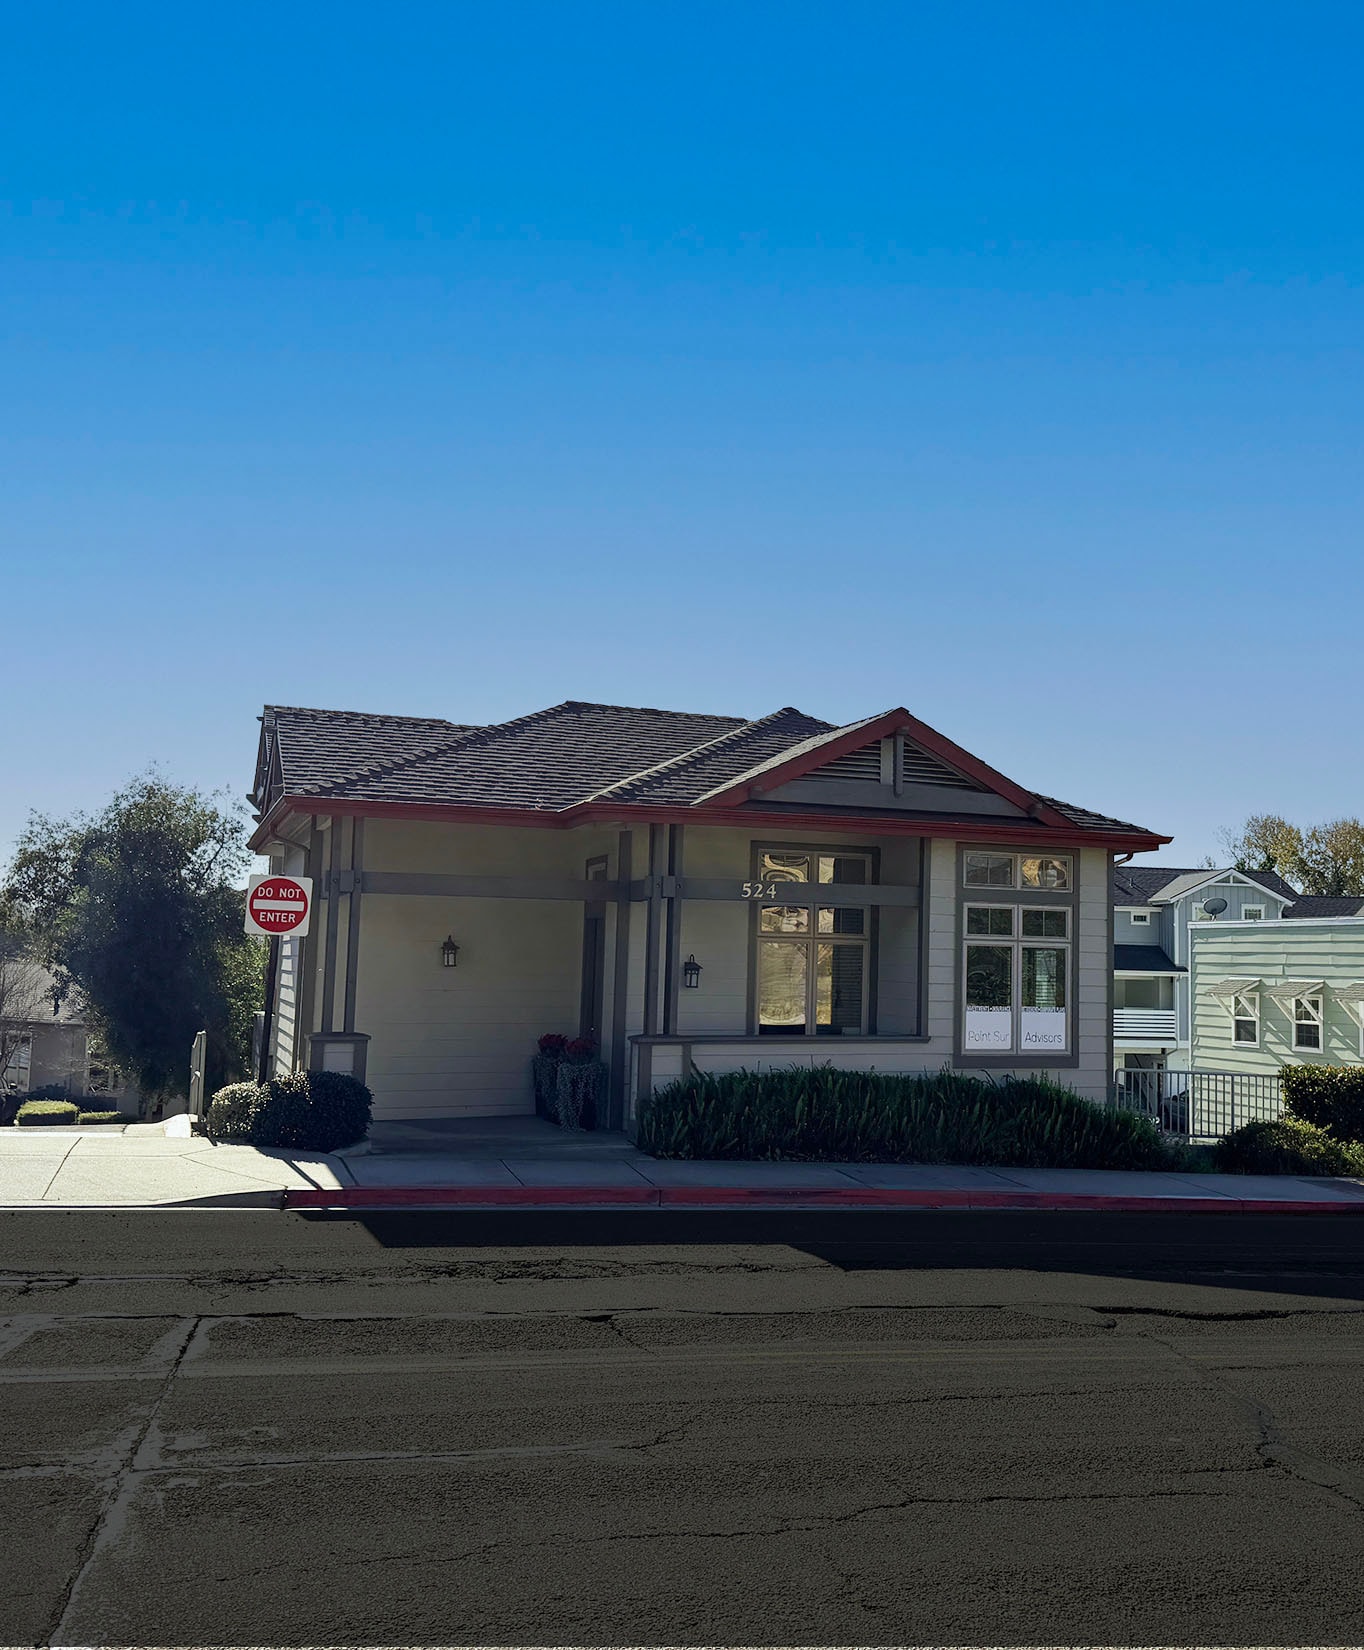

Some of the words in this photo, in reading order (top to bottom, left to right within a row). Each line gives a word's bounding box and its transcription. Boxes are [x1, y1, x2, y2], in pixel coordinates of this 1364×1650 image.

[258, 887, 273, 897] DO
[280, 888, 301, 898] NOT
[741, 882, 777, 899] 524
[260, 912, 295, 923] ENTER
[968, 1030, 992, 1042] Point
[993, 1031, 1010, 1043] Sur
[1025, 1031, 1063, 1043] Advisors
